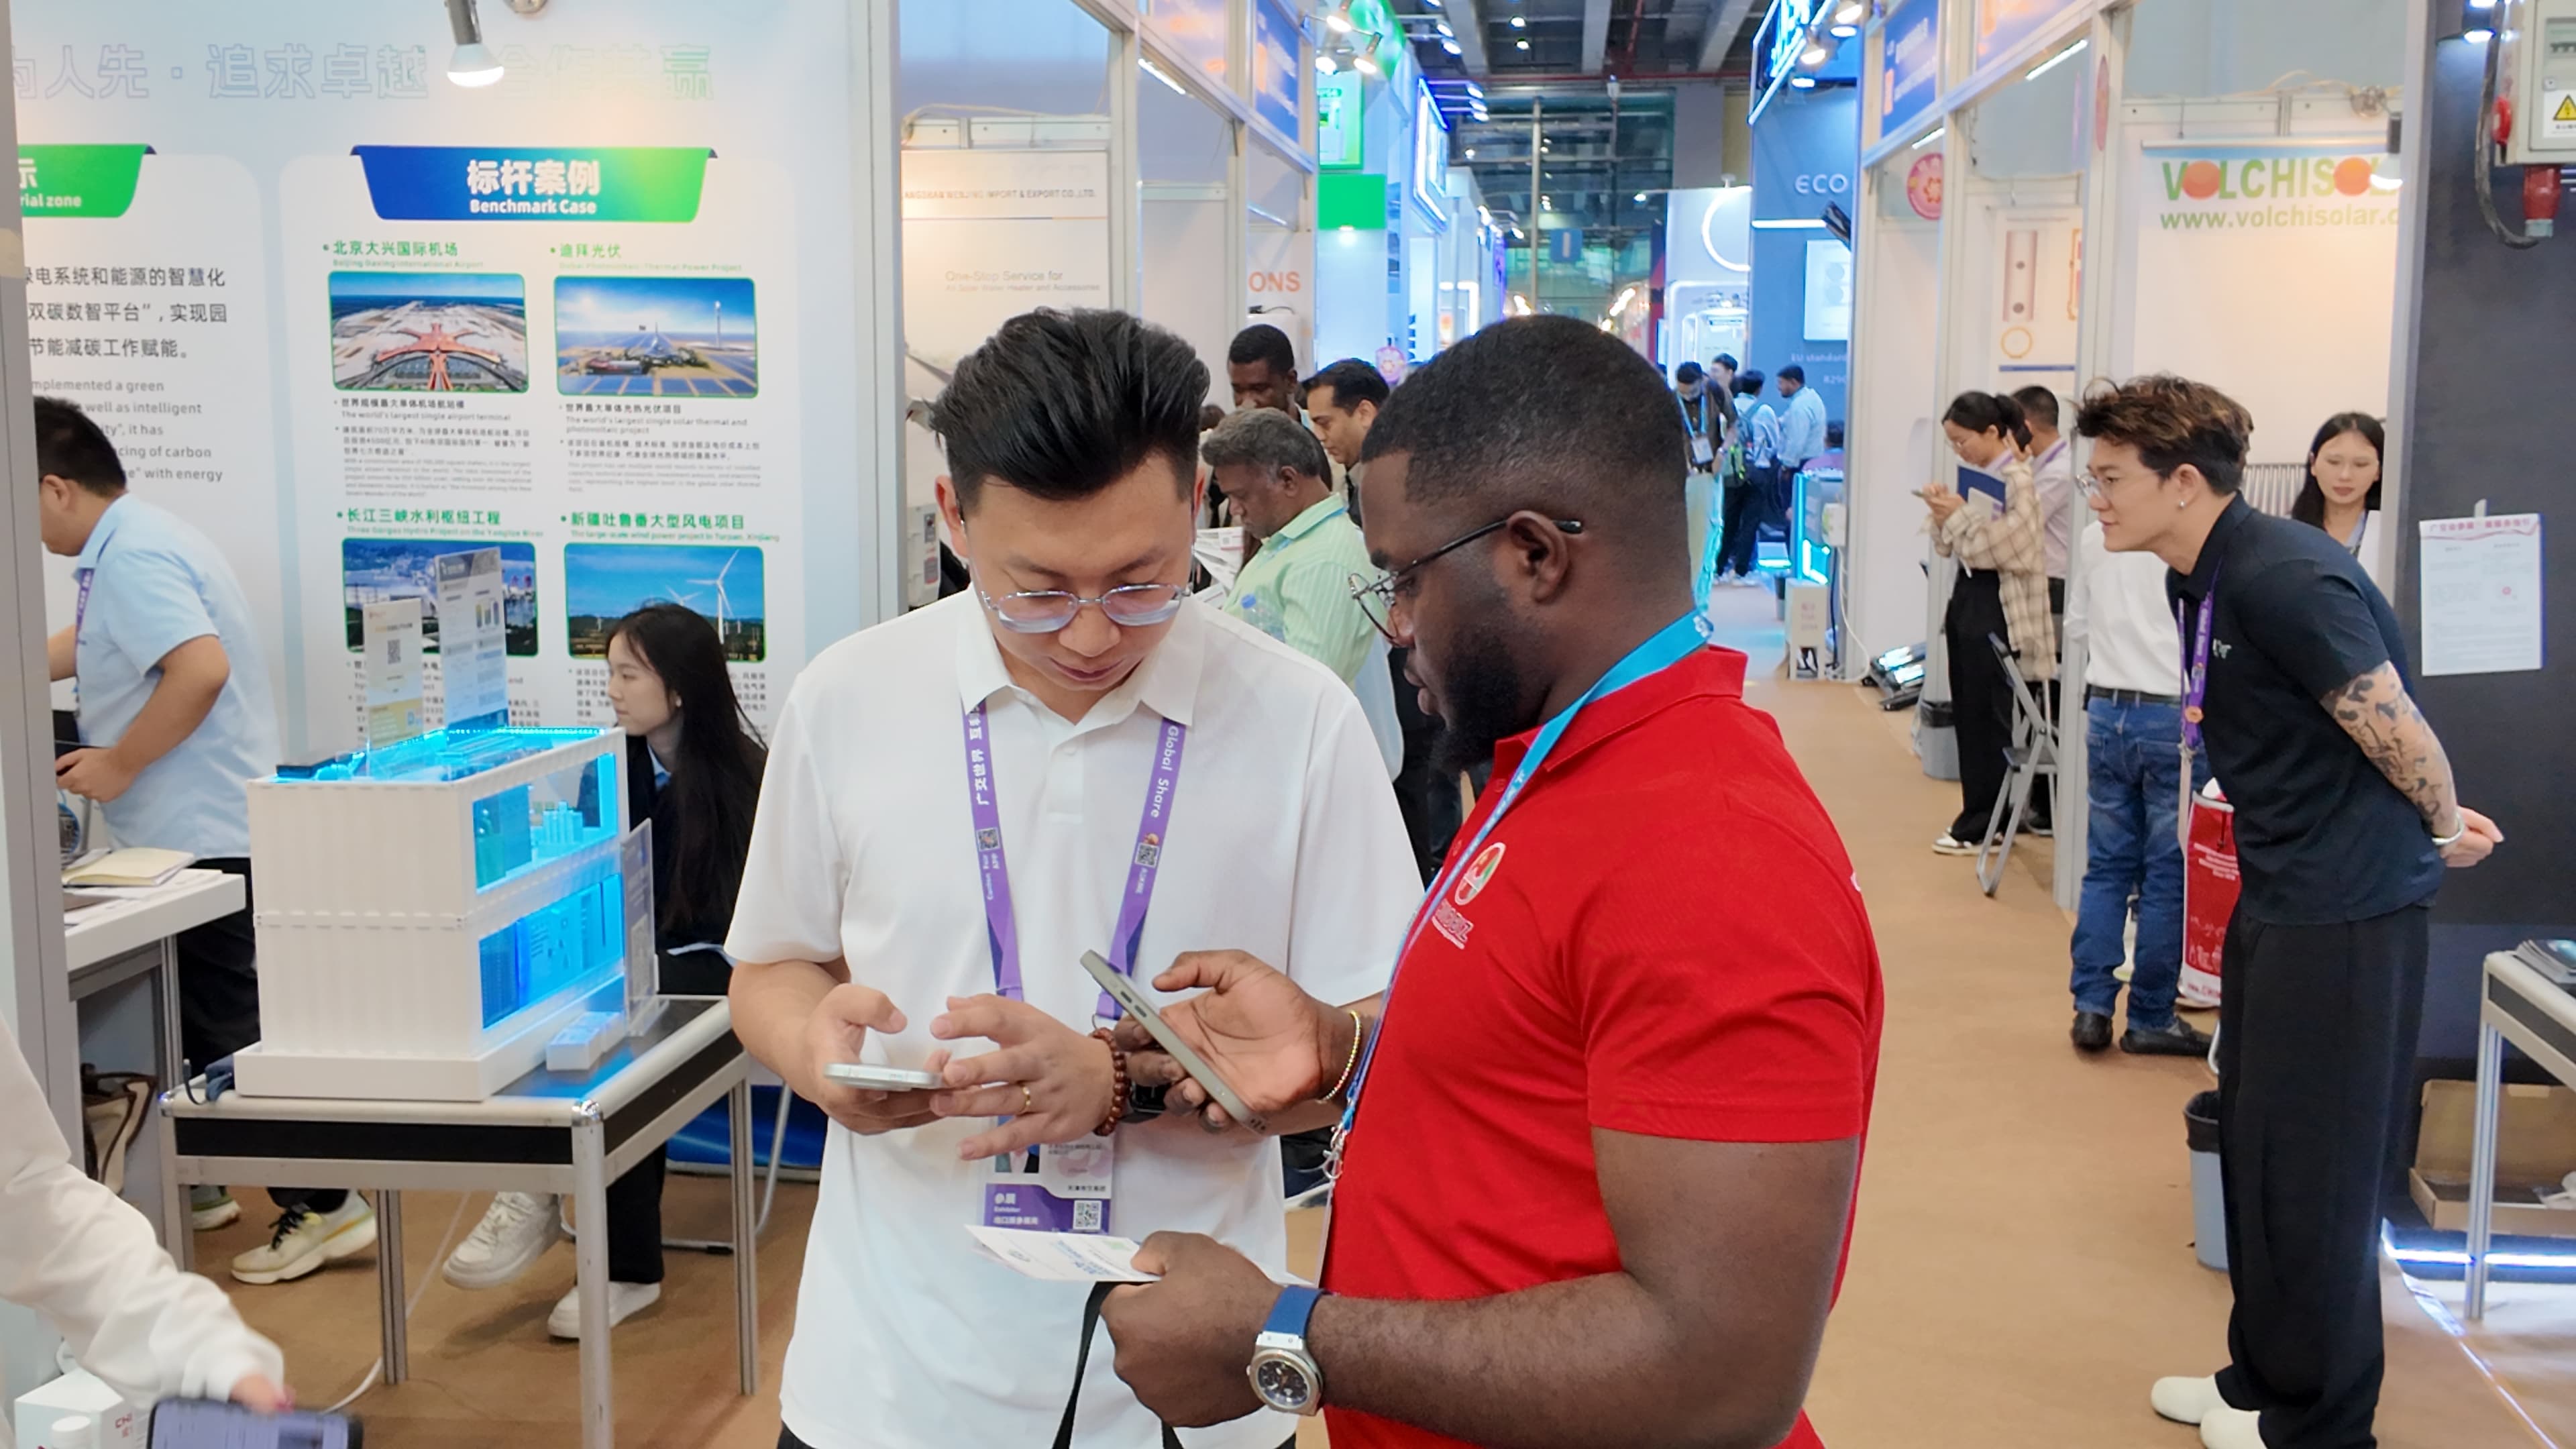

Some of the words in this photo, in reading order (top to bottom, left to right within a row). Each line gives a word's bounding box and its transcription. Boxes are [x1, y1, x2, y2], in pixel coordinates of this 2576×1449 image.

[467, 160, 601, 196] 标杆案例
[46, 196, 82, 207] zone
[1026, 189, 1060, 199] EXPORT
[470, 199, 557, 214] Benchmark
[559, 200, 597, 215] Case
[333, 240, 458, 256] 北京大兴国际机场
[1048, 270, 1063, 280] for
[1248, 270, 1301, 292] ONS
[32, 379, 112, 392] mplemented
[115, 382, 123, 392] a
[125, 382, 164, 394] green
[86, 402, 113, 414] well
[115, 404, 131, 414] as
[133, 402, 202, 417] intelligent
[140, 425, 164, 436] has
[149, 446, 162, 458] of
[165, 447, 212, 459] carbon
[144, 468, 173, 479] with
[176, 470, 223, 483] energy
[347, 507, 501, 525] 长江三峡水利枢纽工程
[571, 512, 745, 530] 新疆吐鲁番大型风电项目
[1161, 724, 1179, 772] Global
[971, 749, 989, 806] 广交世界
[1150, 777, 1169, 818] Share
